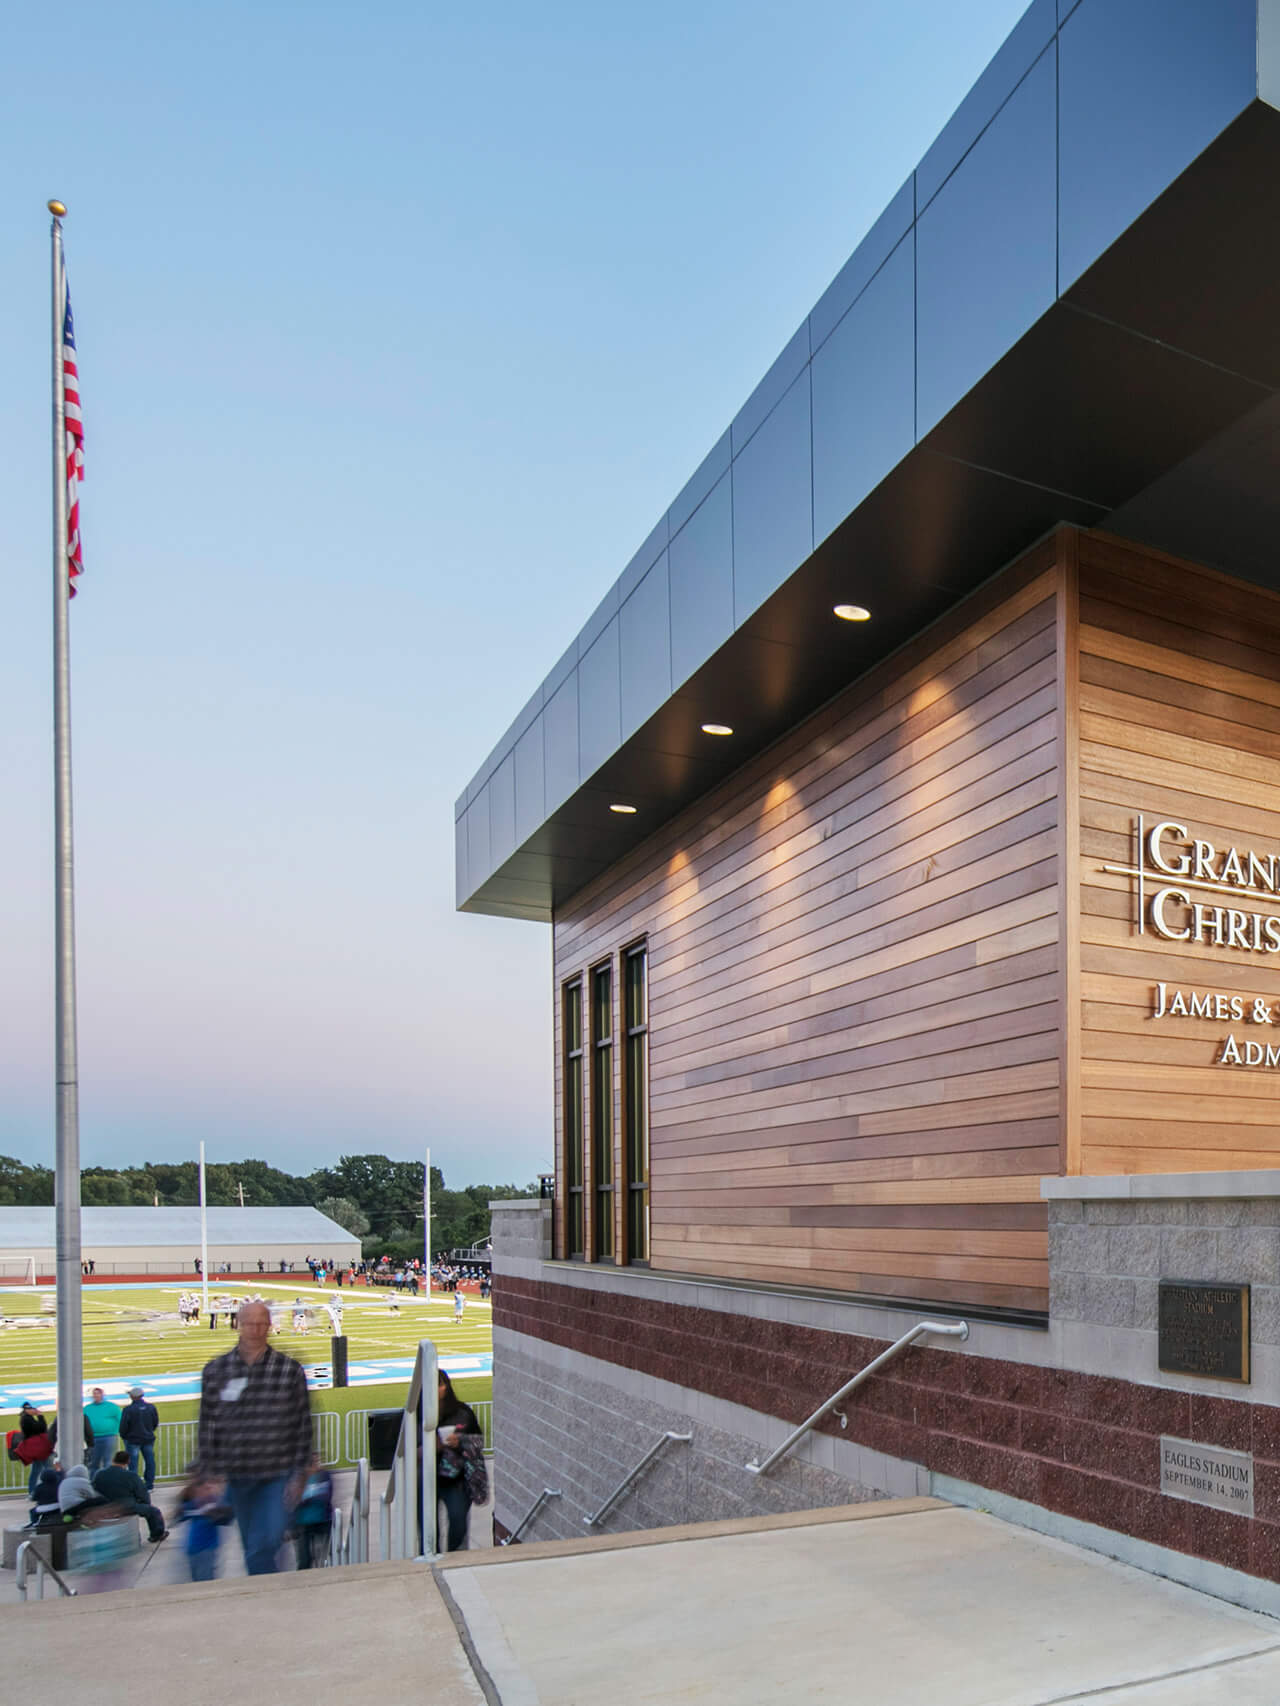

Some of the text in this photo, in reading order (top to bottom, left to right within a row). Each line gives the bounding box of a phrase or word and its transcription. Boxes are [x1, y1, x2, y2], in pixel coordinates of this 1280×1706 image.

[1154, 982, 1244, 1021] JAMES
[1252, 998, 1272, 1024] &
[1164, 1449, 1249, 1484] EAGLES STADIUM
[1164, 1469, 1213, 1493] SEPTEMBER
[1230, 1486, 1249, 1501] 2007
